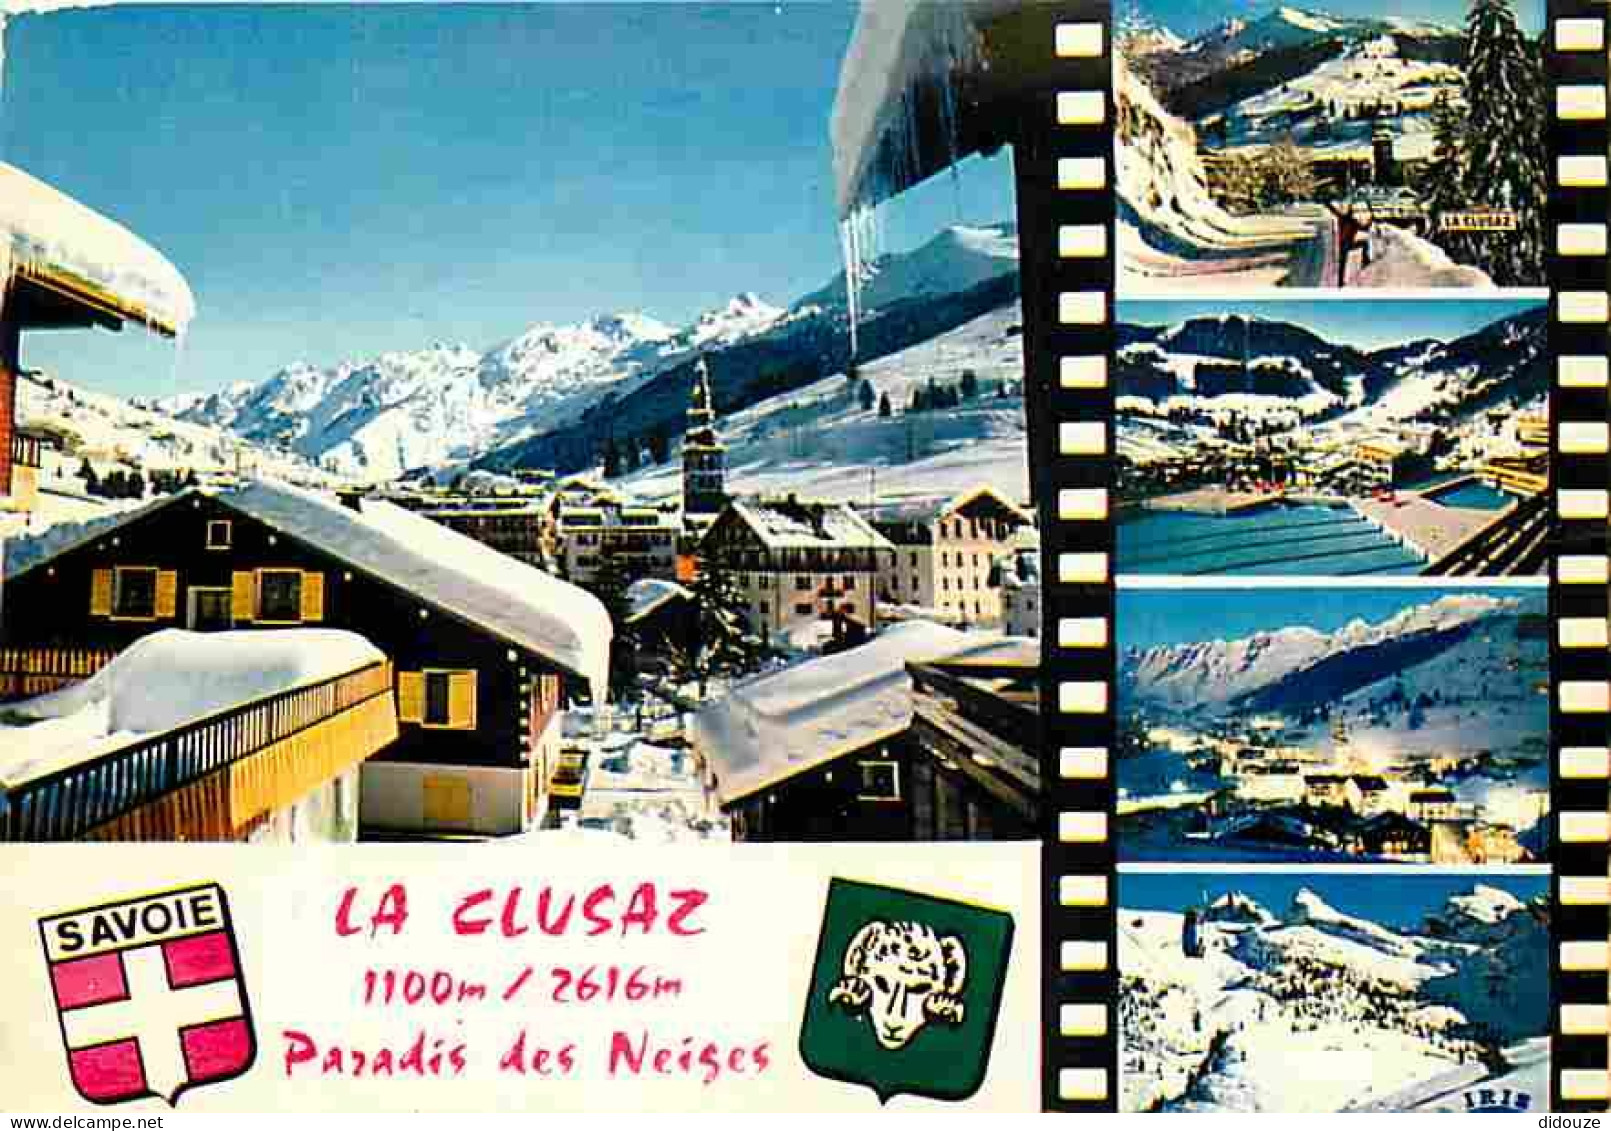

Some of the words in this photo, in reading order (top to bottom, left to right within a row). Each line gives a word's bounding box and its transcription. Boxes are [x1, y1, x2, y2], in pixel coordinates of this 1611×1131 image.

[56, 894, 217, 952] SAVOIE
[336, 883, 408, 937] LA
[452, 882, 708, 937] CLUSAZ
[364, 969, 486, 1002] 1100m
[552, 967, 682, 1001] 2616m
[283, 1030, 467, 1077] Paradis
[499, 1030, 575, 1075] des
[608, 1030, 769, 1085] Neiges
[1463, 1089, 1531, 1109] IRIS
